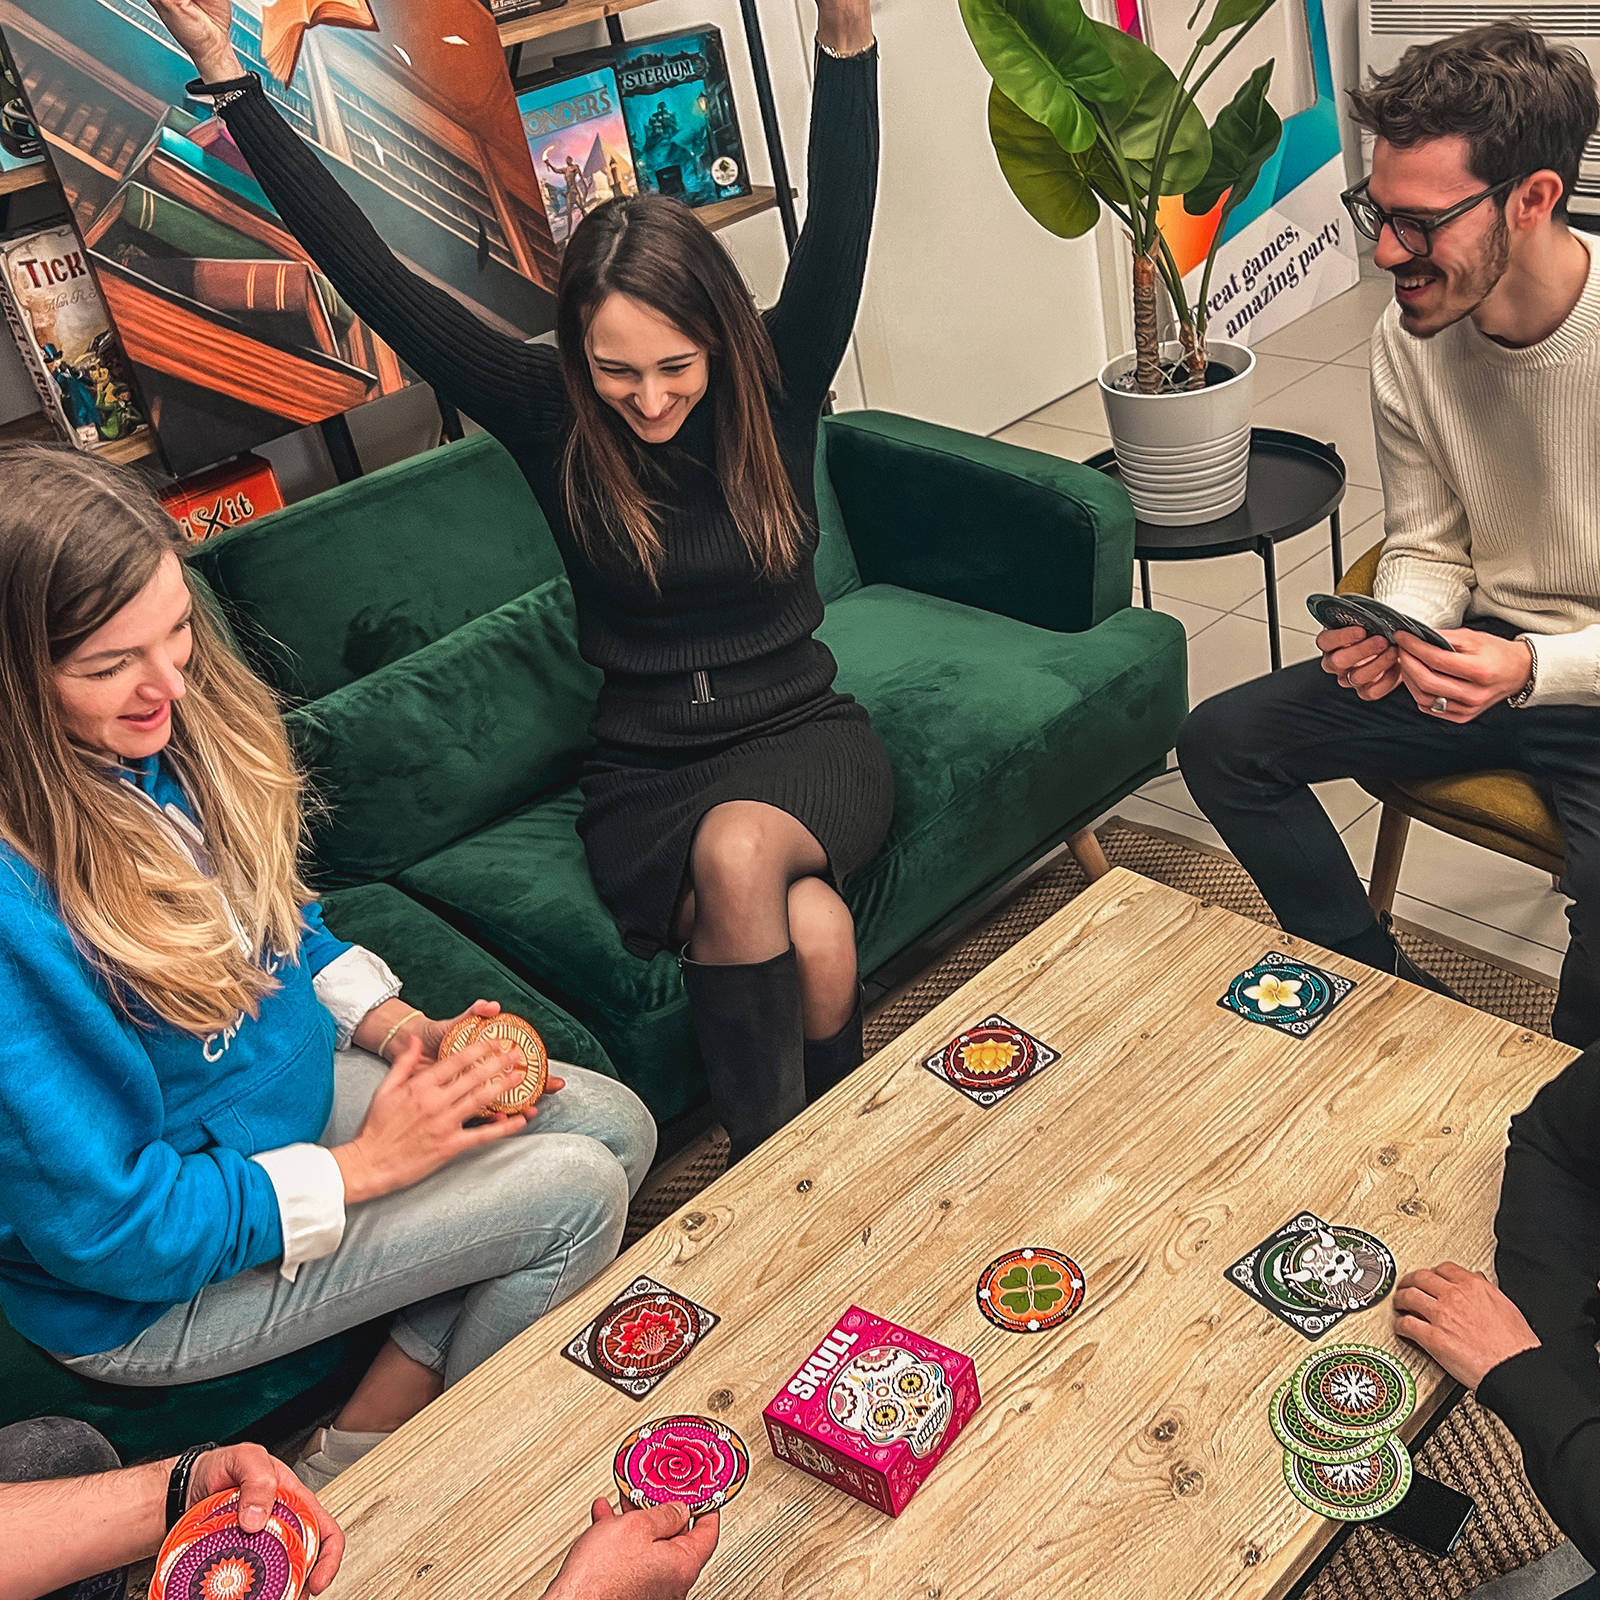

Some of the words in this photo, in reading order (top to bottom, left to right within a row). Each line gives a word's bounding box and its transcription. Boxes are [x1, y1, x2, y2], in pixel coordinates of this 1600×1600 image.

[621, 59, 695, 90] STERIUM
[522, 89, 612, 136] ONDERS
[1225, 257, 1299, 339] amazing
[1298, 218, 1340, 277] party
[1242, 225, 1300, 292] games,
[787, 1329, 859, 1401] SKULL
